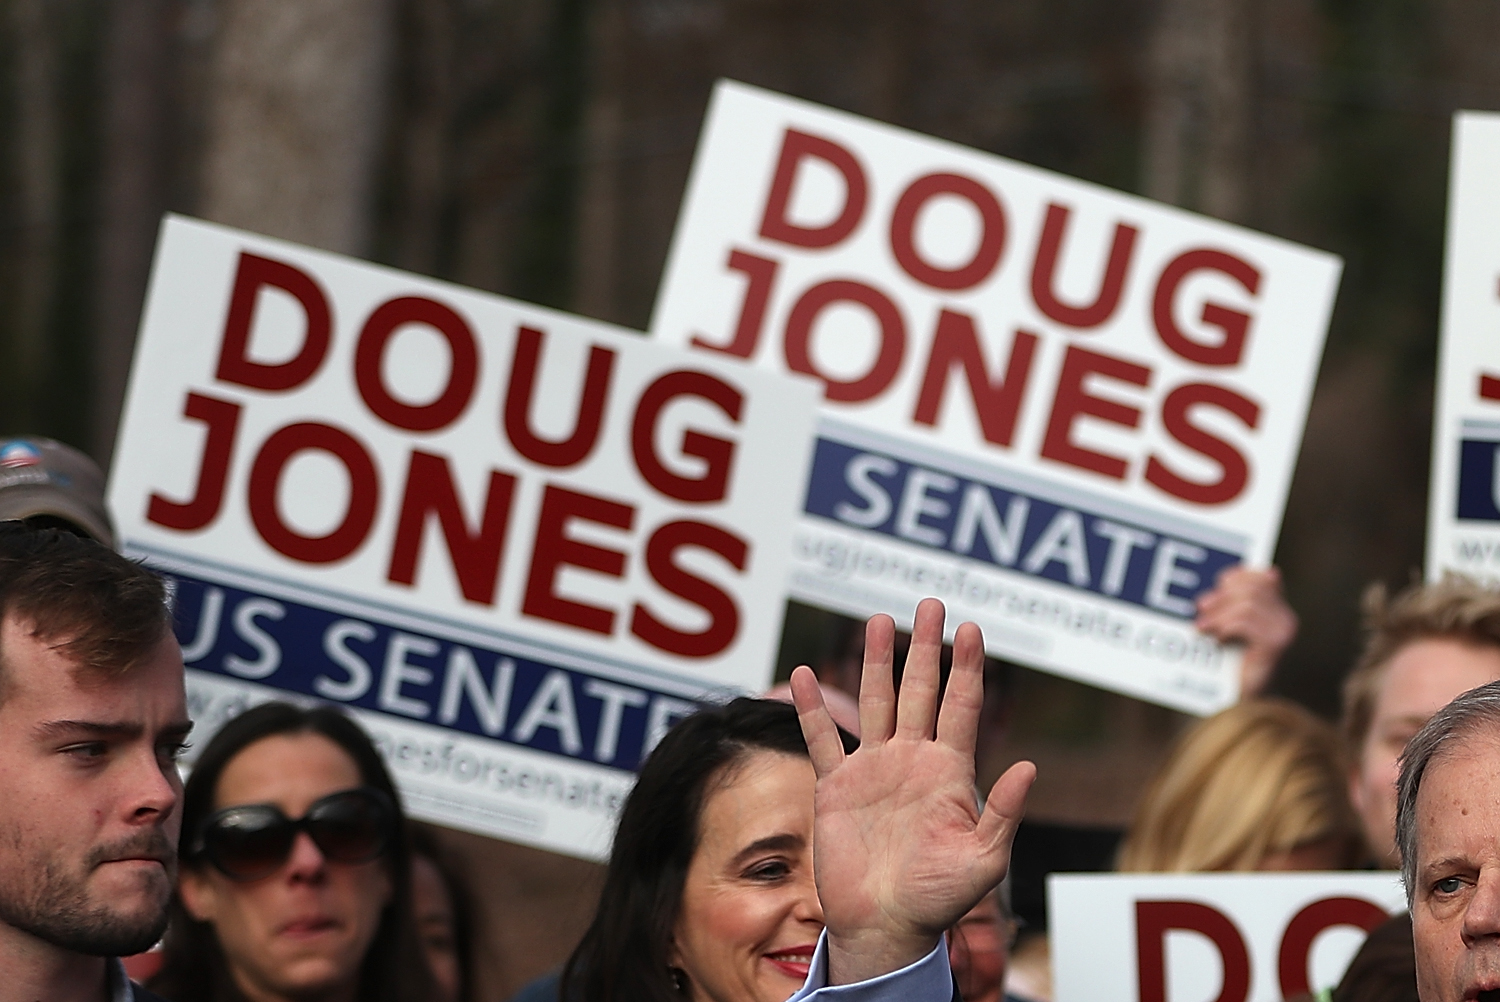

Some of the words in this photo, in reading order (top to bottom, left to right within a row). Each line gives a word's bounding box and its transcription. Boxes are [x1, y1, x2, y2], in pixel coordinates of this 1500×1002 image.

[755, 125, 1266, 370] DOUG
[215, 252, 745, 506] DOUG
[689, 248, 1265, 508] JONES
[146, 393, 751, 661] JONES
[833, 452, 1208, 617] SENATE
